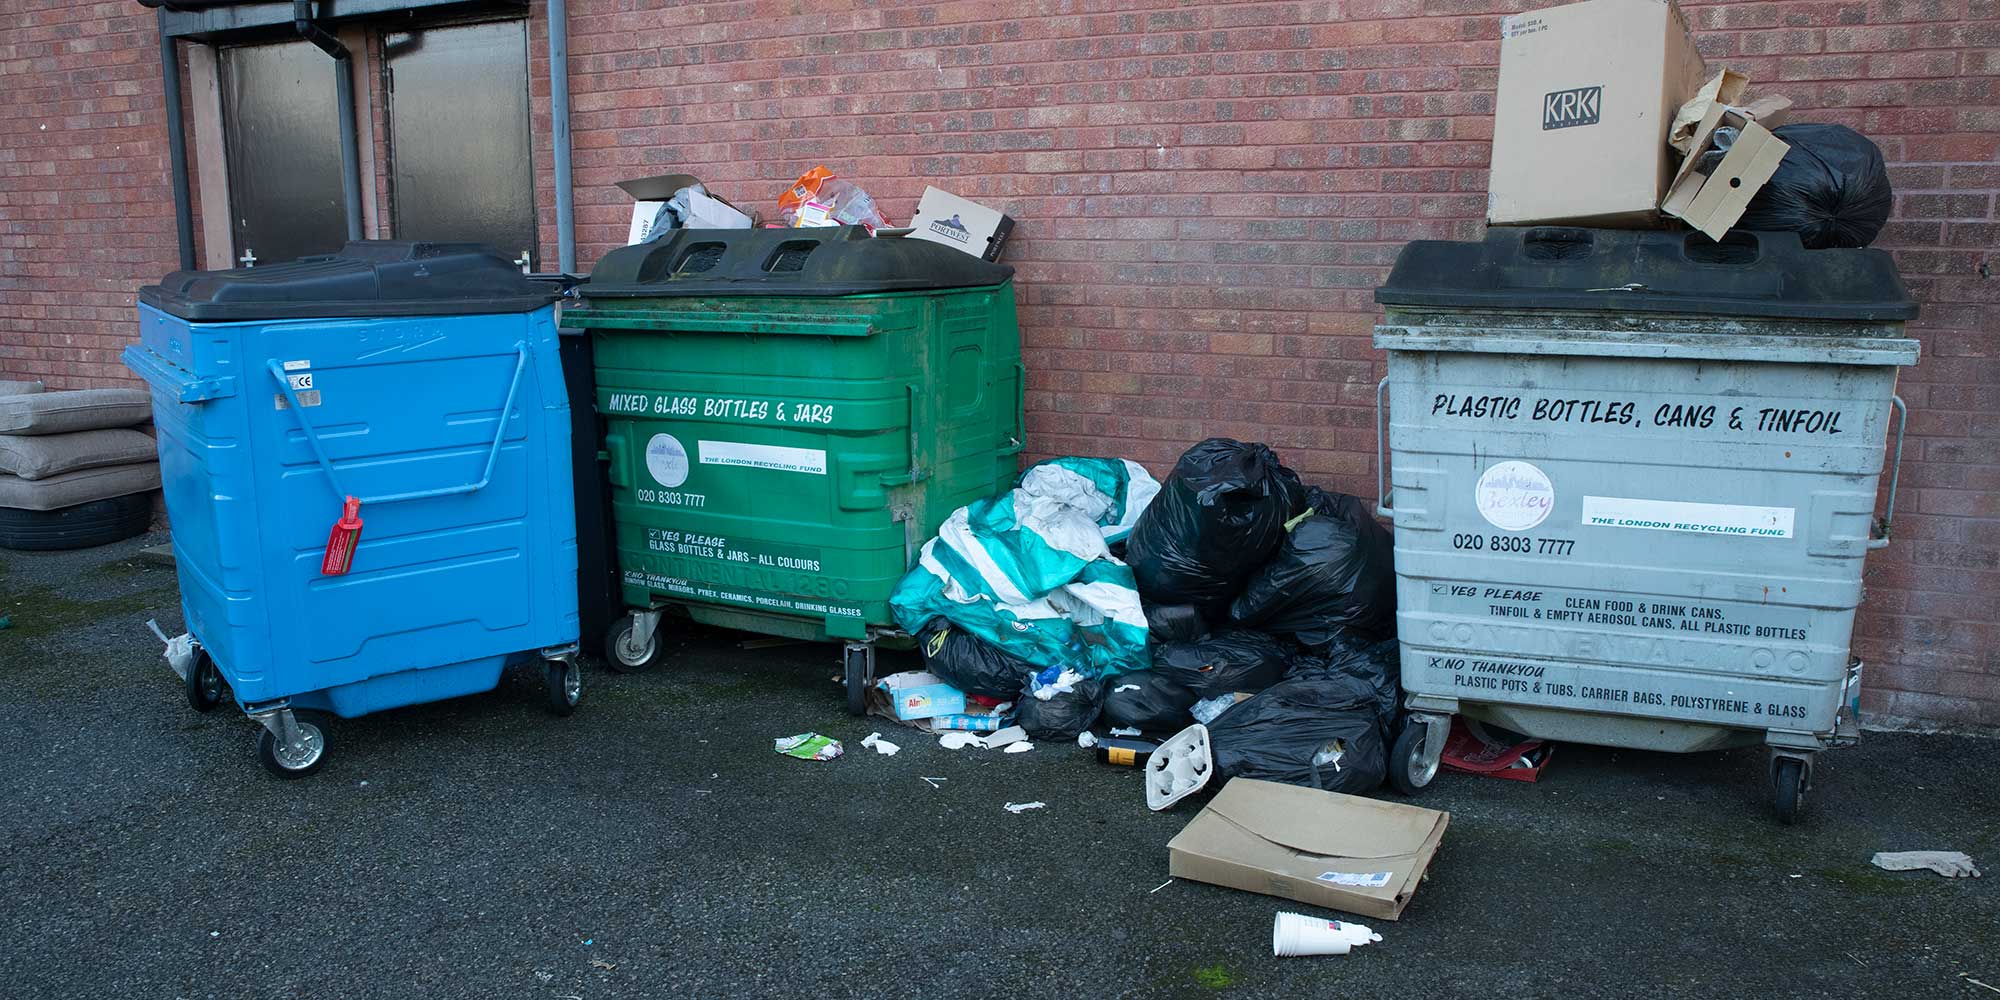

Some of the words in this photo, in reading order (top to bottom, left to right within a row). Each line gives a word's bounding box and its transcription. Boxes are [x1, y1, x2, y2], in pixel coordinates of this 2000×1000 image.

[1545, 89, 1592, 124] KRK
[930, 222, 970, 242] PORTWEST
[298, 376, 311, 387] CE
[609, 394, 648, 412] MIXED
[654, 396, 697, 416] GLASS
[704, 398, 768, 420] BOTTLES
[776, 402, 786, 421] &
[794, 403, 834, 424] JARS
[1432, 394, 1521, 419] PLASTIC
[1532, 398, 1642, 429] BOTTLES,
[1654, 403, 1716, 429] CANS
[1728, 407, 1744, 431] &
[1758, 408, 1842, 435] TINFOIL
[721, 458, 752, 466] LONDON
[753, 461, 797, 470] RECYCLING
[800, 465, 822, 473] FUND
[638, 488, 655, 502] 020
[658, 490, 681, 505] 8303
[684, 493, 705, 507] 7777
[1591, 516, 1615, 525] THE
[1618, 518, 1671, 529] LONDON
[1674, 522, 1746, 534] RECYCLING
[1750, 527, 1785, 536] FUND
[662, 530, 680, 542] YES
[685, 533, 726, 548] PLEASE
[1453, 534, 1484, 550] 020
[1490, 535, 1531, 553] 8303
[1538, 538, 1575, 556] 7777
[649, 540, 676, 553] GLASS
[678, 543, 714, 558] BOTTLES
[717, 548, 724, 559] &
[726, 550, 750, 563] JARS
[758, 554, 775, 566] ALL
[778, 556, 821, 572] COLOURS
[632, 571, 644, 579] NO
[646, 573, 688, 585] THANKYOU
[1450, 585, 1477, 597] YES
[1484, 588, 1543, 602] PLEASE
[795, 601, 827, 613] DRINKING
[829, 606, 862, 616] GLASSES
[1565, 597, 1600, 610] CLEAN
[1604, 600, 1633, 612] FOOD
[1638, 602, 1646, 614] &
[1652, 603, 1686, 617] DRINK
[1489, 605, 1529, 618] TINFOIL
[1534, 608, 1542, 619] &
[1547, 609, 1584, 622] EMPTY
[1587, 612, 1637, 626] AEROSOL
[1680, 620, 1700, 632] ALL
[1705, 622, 1750, 636] PLASTIC
[1755, 626, 1806, 640] BOTTLES
[1444, 658, 1465, 670] NO
[1471, 660, 1544, 678] THANKYOU
[1454, 674, 1497, 689] PLASTIC
[1501, 678, 1528, 692] POTS
[1533, 681, 1542, 694] &
[1581, 686, 1628, 702] CARRIER
[1671, 694, 1749, 713] POLYSTYRENE
[1753, 702, 1762, 714] &
[1768, 703, 1806, 719] GLASS
